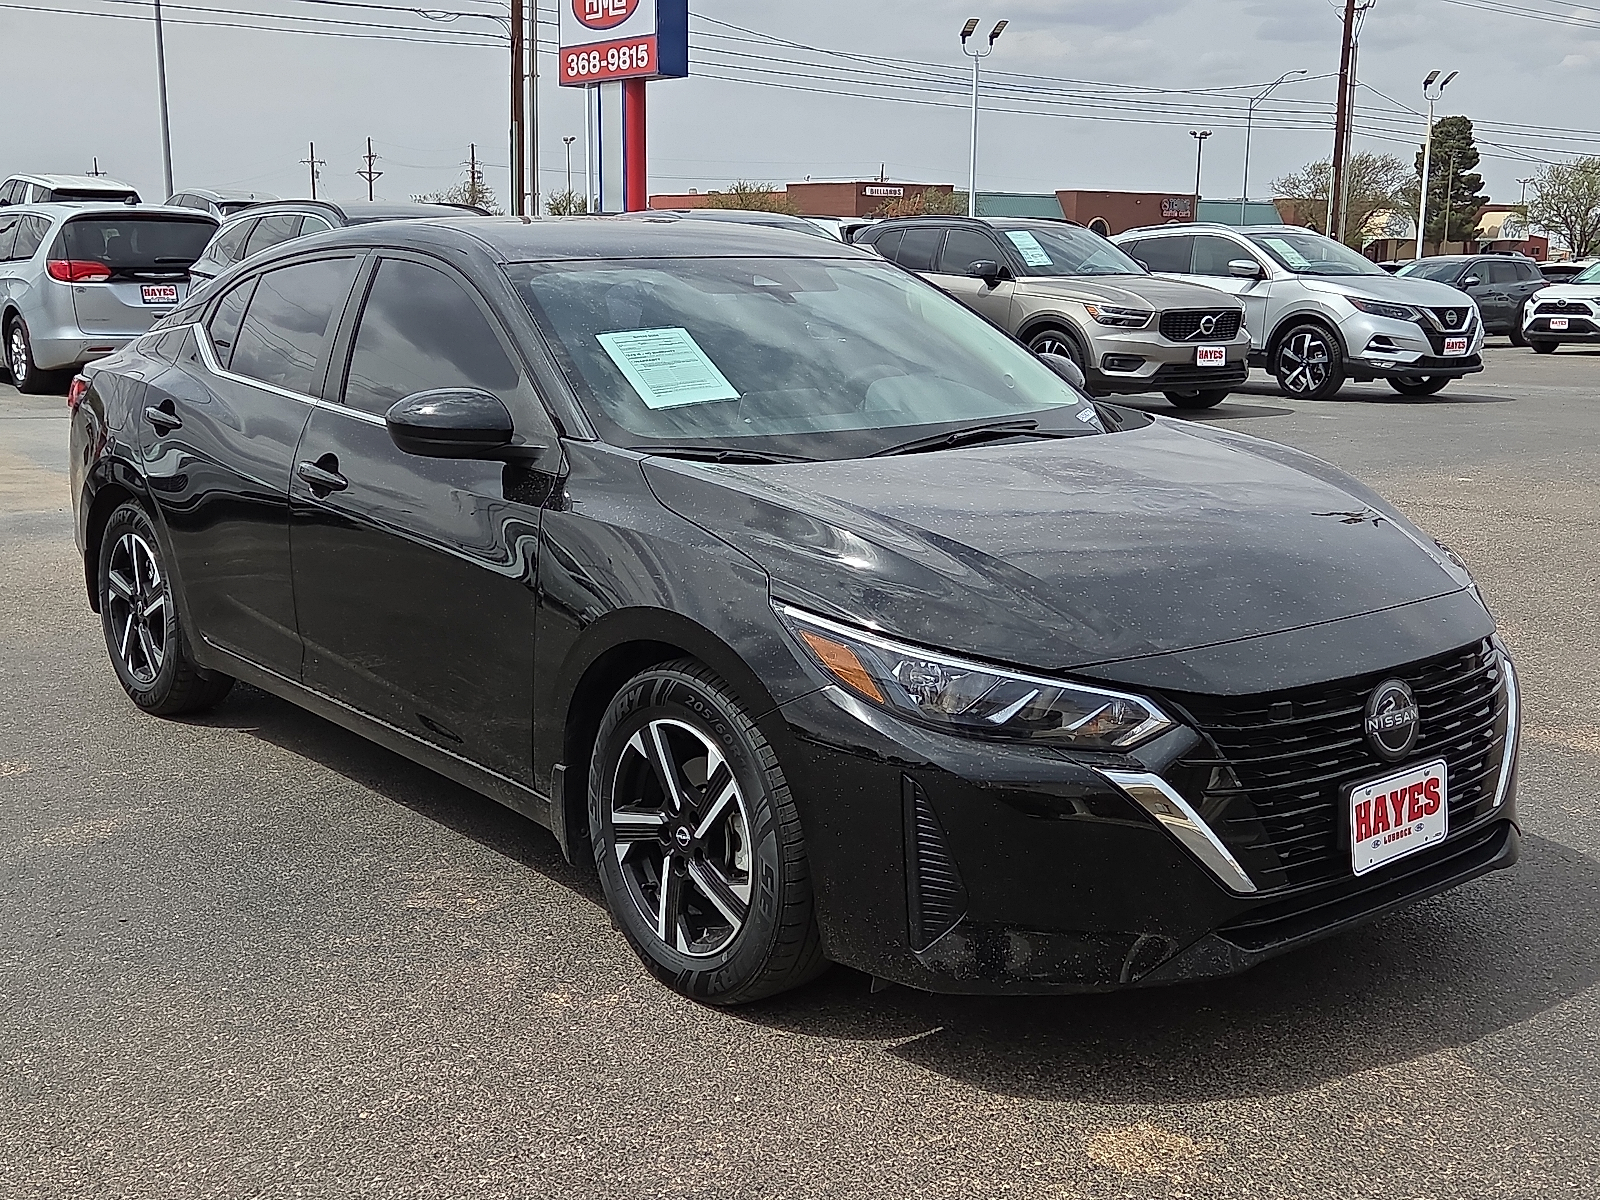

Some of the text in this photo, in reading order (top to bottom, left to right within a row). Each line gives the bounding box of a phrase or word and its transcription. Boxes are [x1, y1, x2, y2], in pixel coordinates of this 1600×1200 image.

[567, 43, 649, 77] 368-9815
[144, 289, 175, 297] HAYES
[1199, 350, 1223, 360] HAYES
[1367, 707, 1418, 731] NISSAN
[1355, 777, 1441, 844] HAYES
[1383, 826, 1413, 845] LUBBOCK
